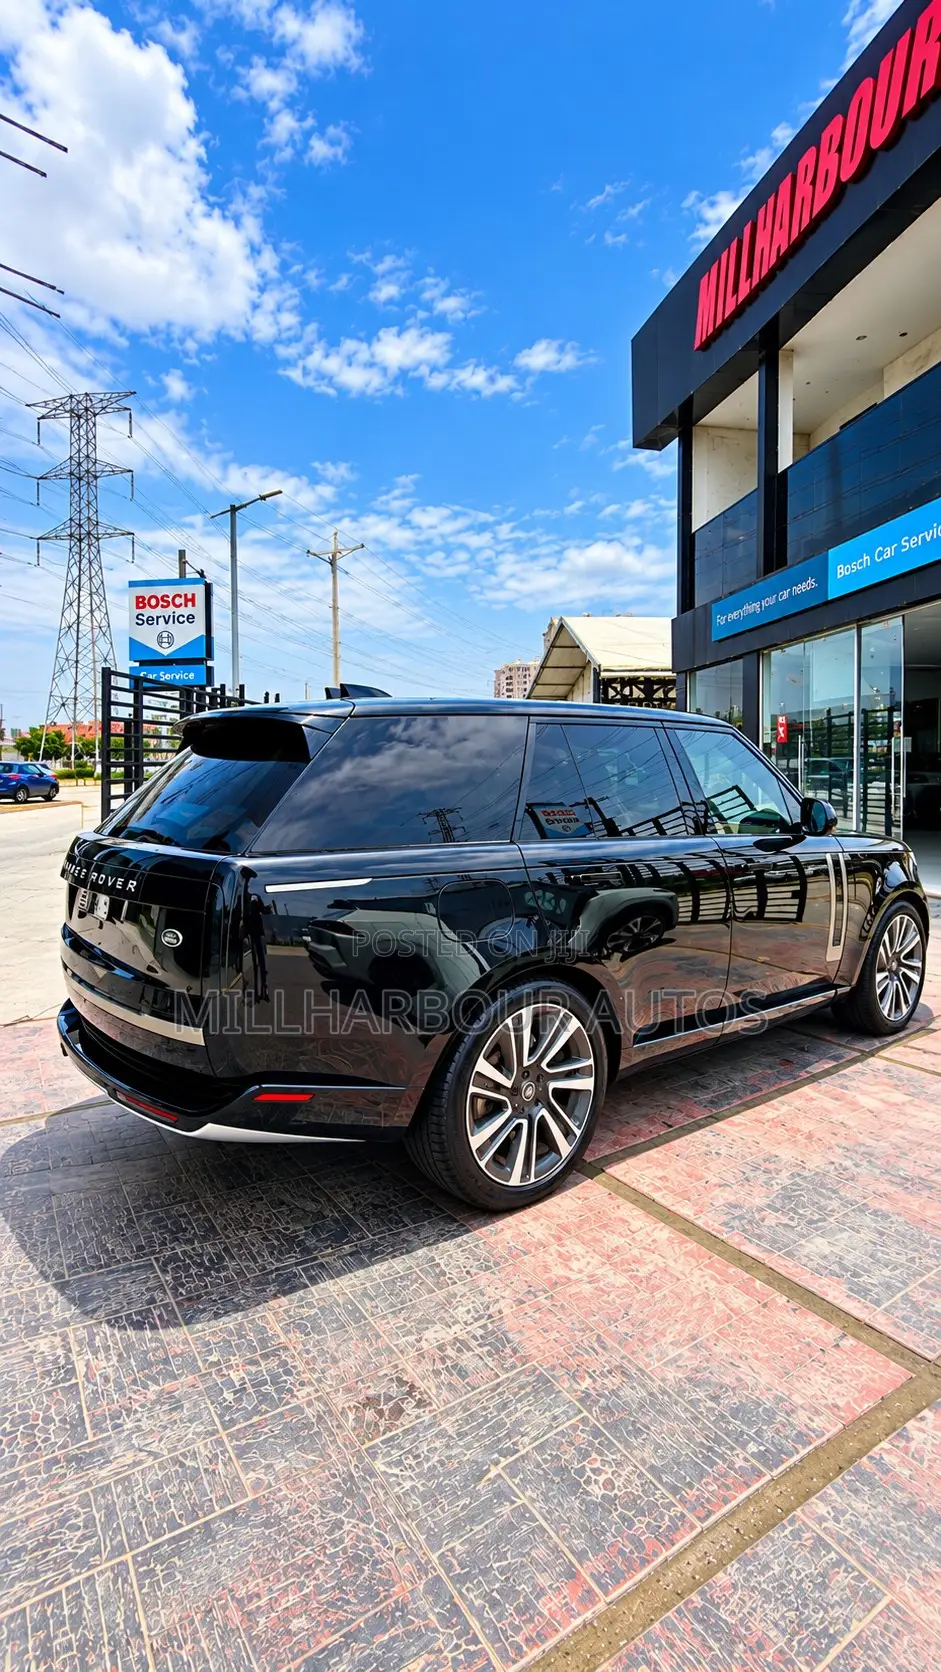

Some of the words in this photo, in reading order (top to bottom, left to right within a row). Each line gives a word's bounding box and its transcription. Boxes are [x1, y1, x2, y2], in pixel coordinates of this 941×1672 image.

[694, 0, 941, 351] MILLHARBOUR
[836, 553, 871, 579] Bosch
[874, 543, 898, 562] Car
[135, 593, 196, 610] BOSCH
[716, 614, 728, 627] For
[728, 601, 761, 621] everything
[761, 594, 778, 611] your
[778, 588, 791, 602] car
[792, 576, 819, 596] needs.
[135, 611, 196, 626] Service
[90, 871, 137, 892] ROVER
